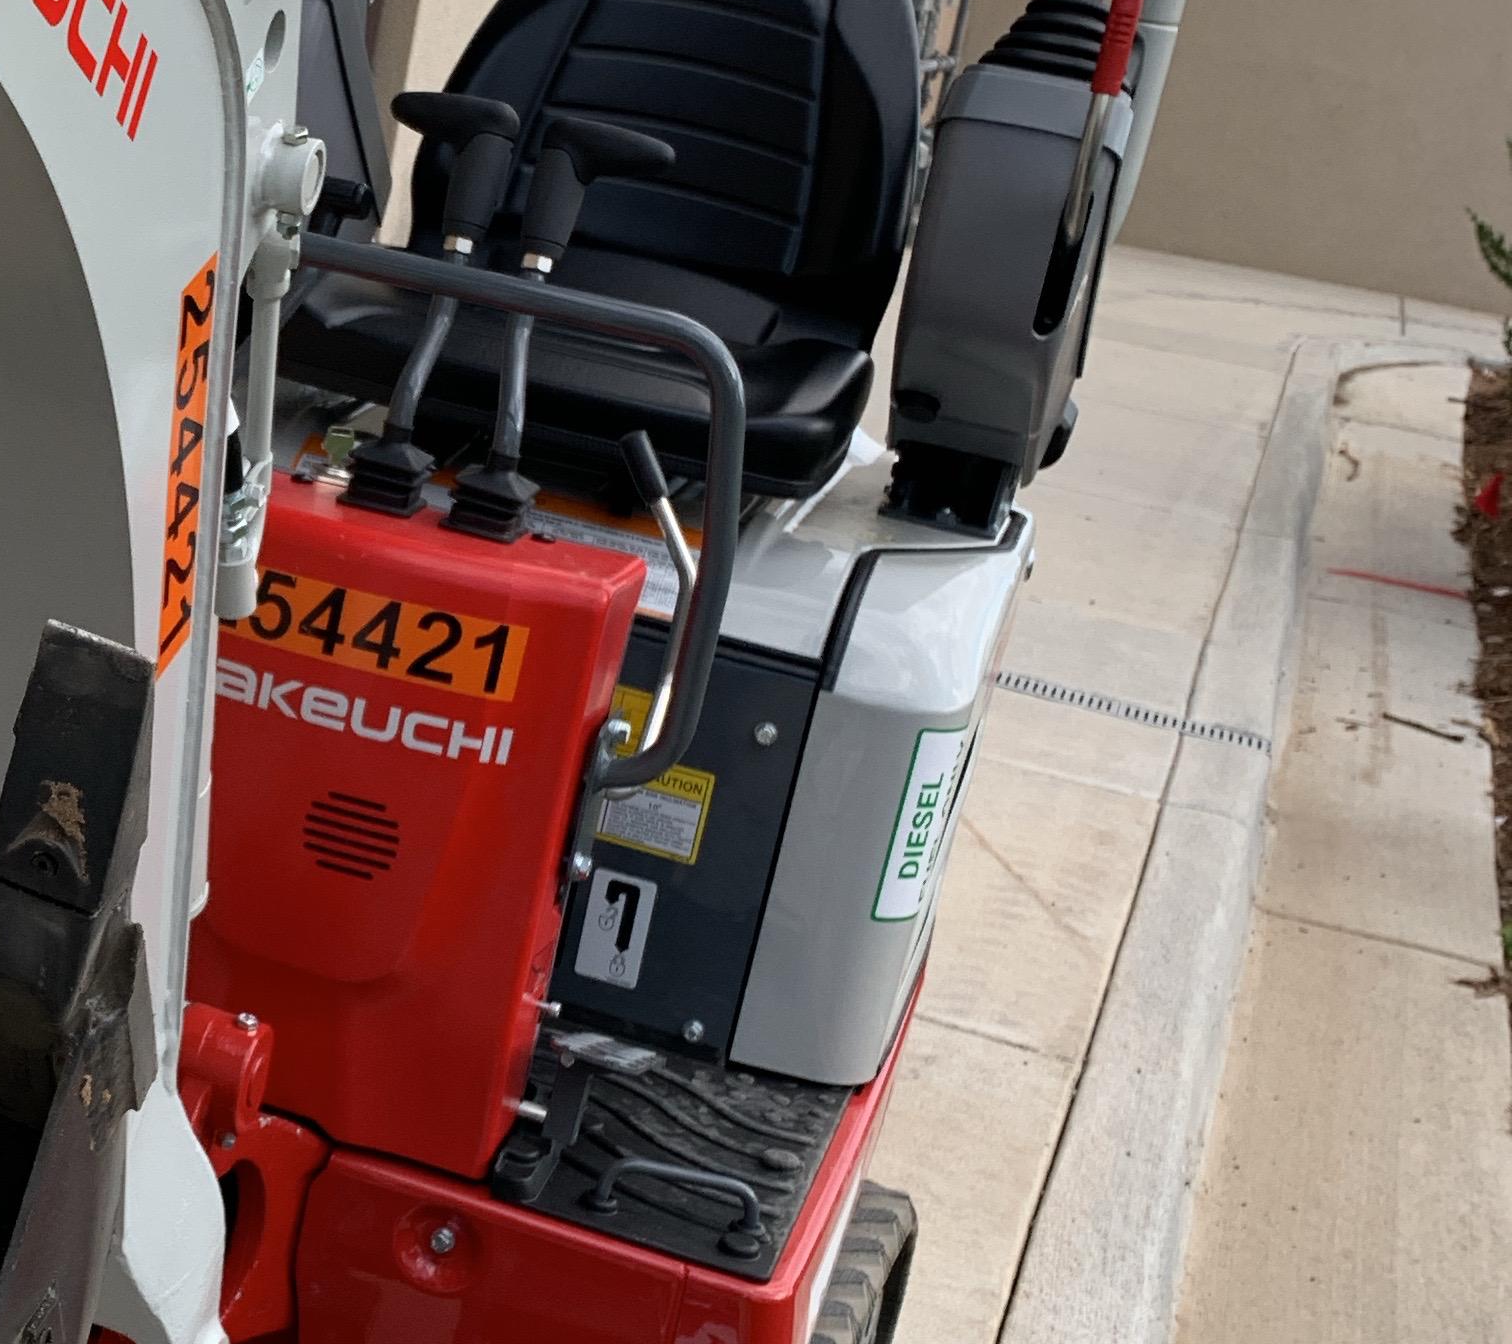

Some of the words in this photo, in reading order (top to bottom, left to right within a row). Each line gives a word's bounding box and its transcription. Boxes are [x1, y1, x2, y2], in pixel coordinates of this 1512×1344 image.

[159, 269, 215, 656] 254421
[219, 569, 510, 694] 54421
[898, 771, 944, 879] DIESEL
